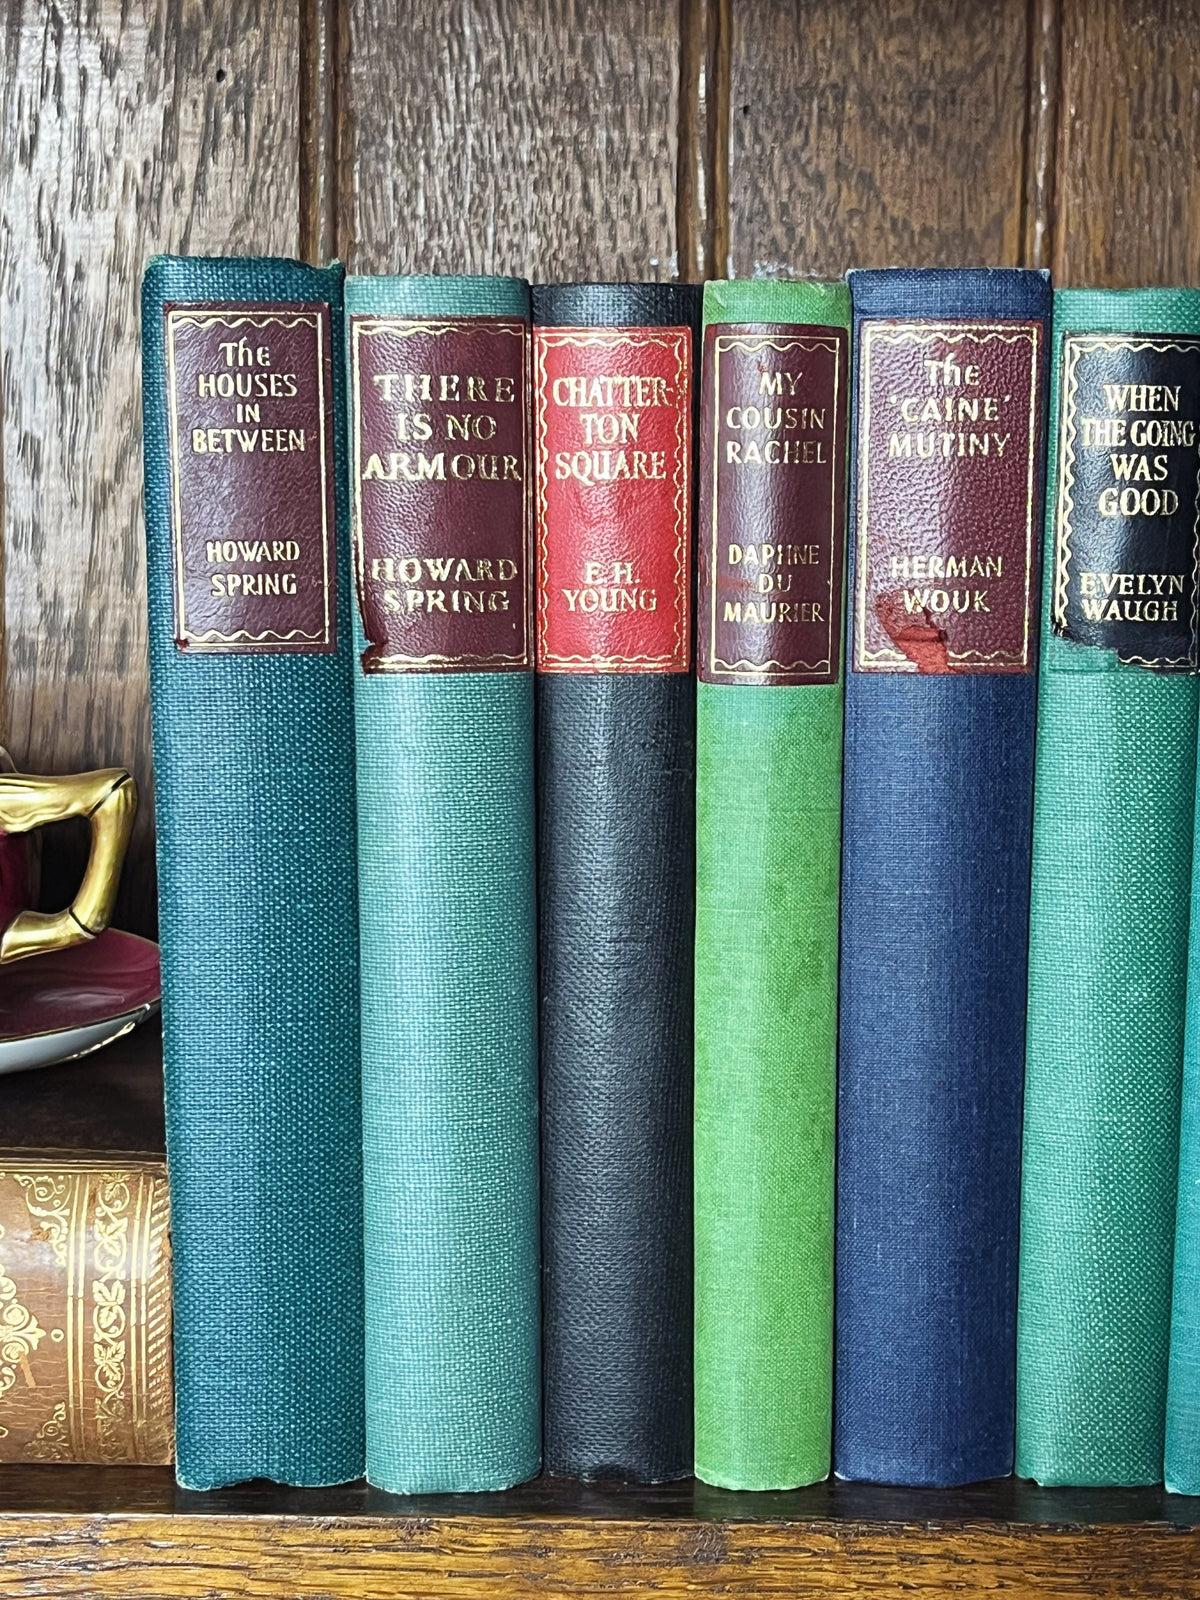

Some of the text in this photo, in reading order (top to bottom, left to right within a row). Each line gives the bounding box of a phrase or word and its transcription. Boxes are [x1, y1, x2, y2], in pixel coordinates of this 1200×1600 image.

[219, 337, 270, 367] The
[923, 353, 980, 386] The
[198, 373, 298, 398] HOUSES
[373, 374, 515, 402] THERE
[552, 376, 674, 407] CHATTER-
[758, 372, 803, 395] MY
[1103, 385, 1182, 412] WHEN
[237, 403, 261, 423] IN
[726, 407, 826, 430] COUSIN
[397, 413, 496, 441] IS NO
[581, 413, 640, 445] TON
[1081, 419, 1195, 448] THE GOING
[192, 429, 305, 453] BETWEEN
[726, 441, 827, 465] RACHEL
[888, 433, 1010, 459] MUTINY
[362, 453, 522, 481] ARMOUR
[555, 451, 667, 486] SQUARE
[1110, 454, 1168, 482] WAS
[1098, 488, 1179, 517] GOOD
[206, 541, 300, 563] HOWARD
[728, 544, 820, 566] DAPHNE
[371, 557, 518, 582] HOWARD
[890, 555, 1003, 578] HERMAN
[211, 574, 297, 597] SPRING
[757, 573, 792, 594] DU
[1080, 572, 1186, 596] EVELYN
[383, 589, 509, 613] SPRING
[562, 588, 657, 613] YOUNG
[723, 602, 825, 624] MAURIER
[902, 589, 991, 614] WOUK
[1081, 600, 1178, 623] WAUGH
